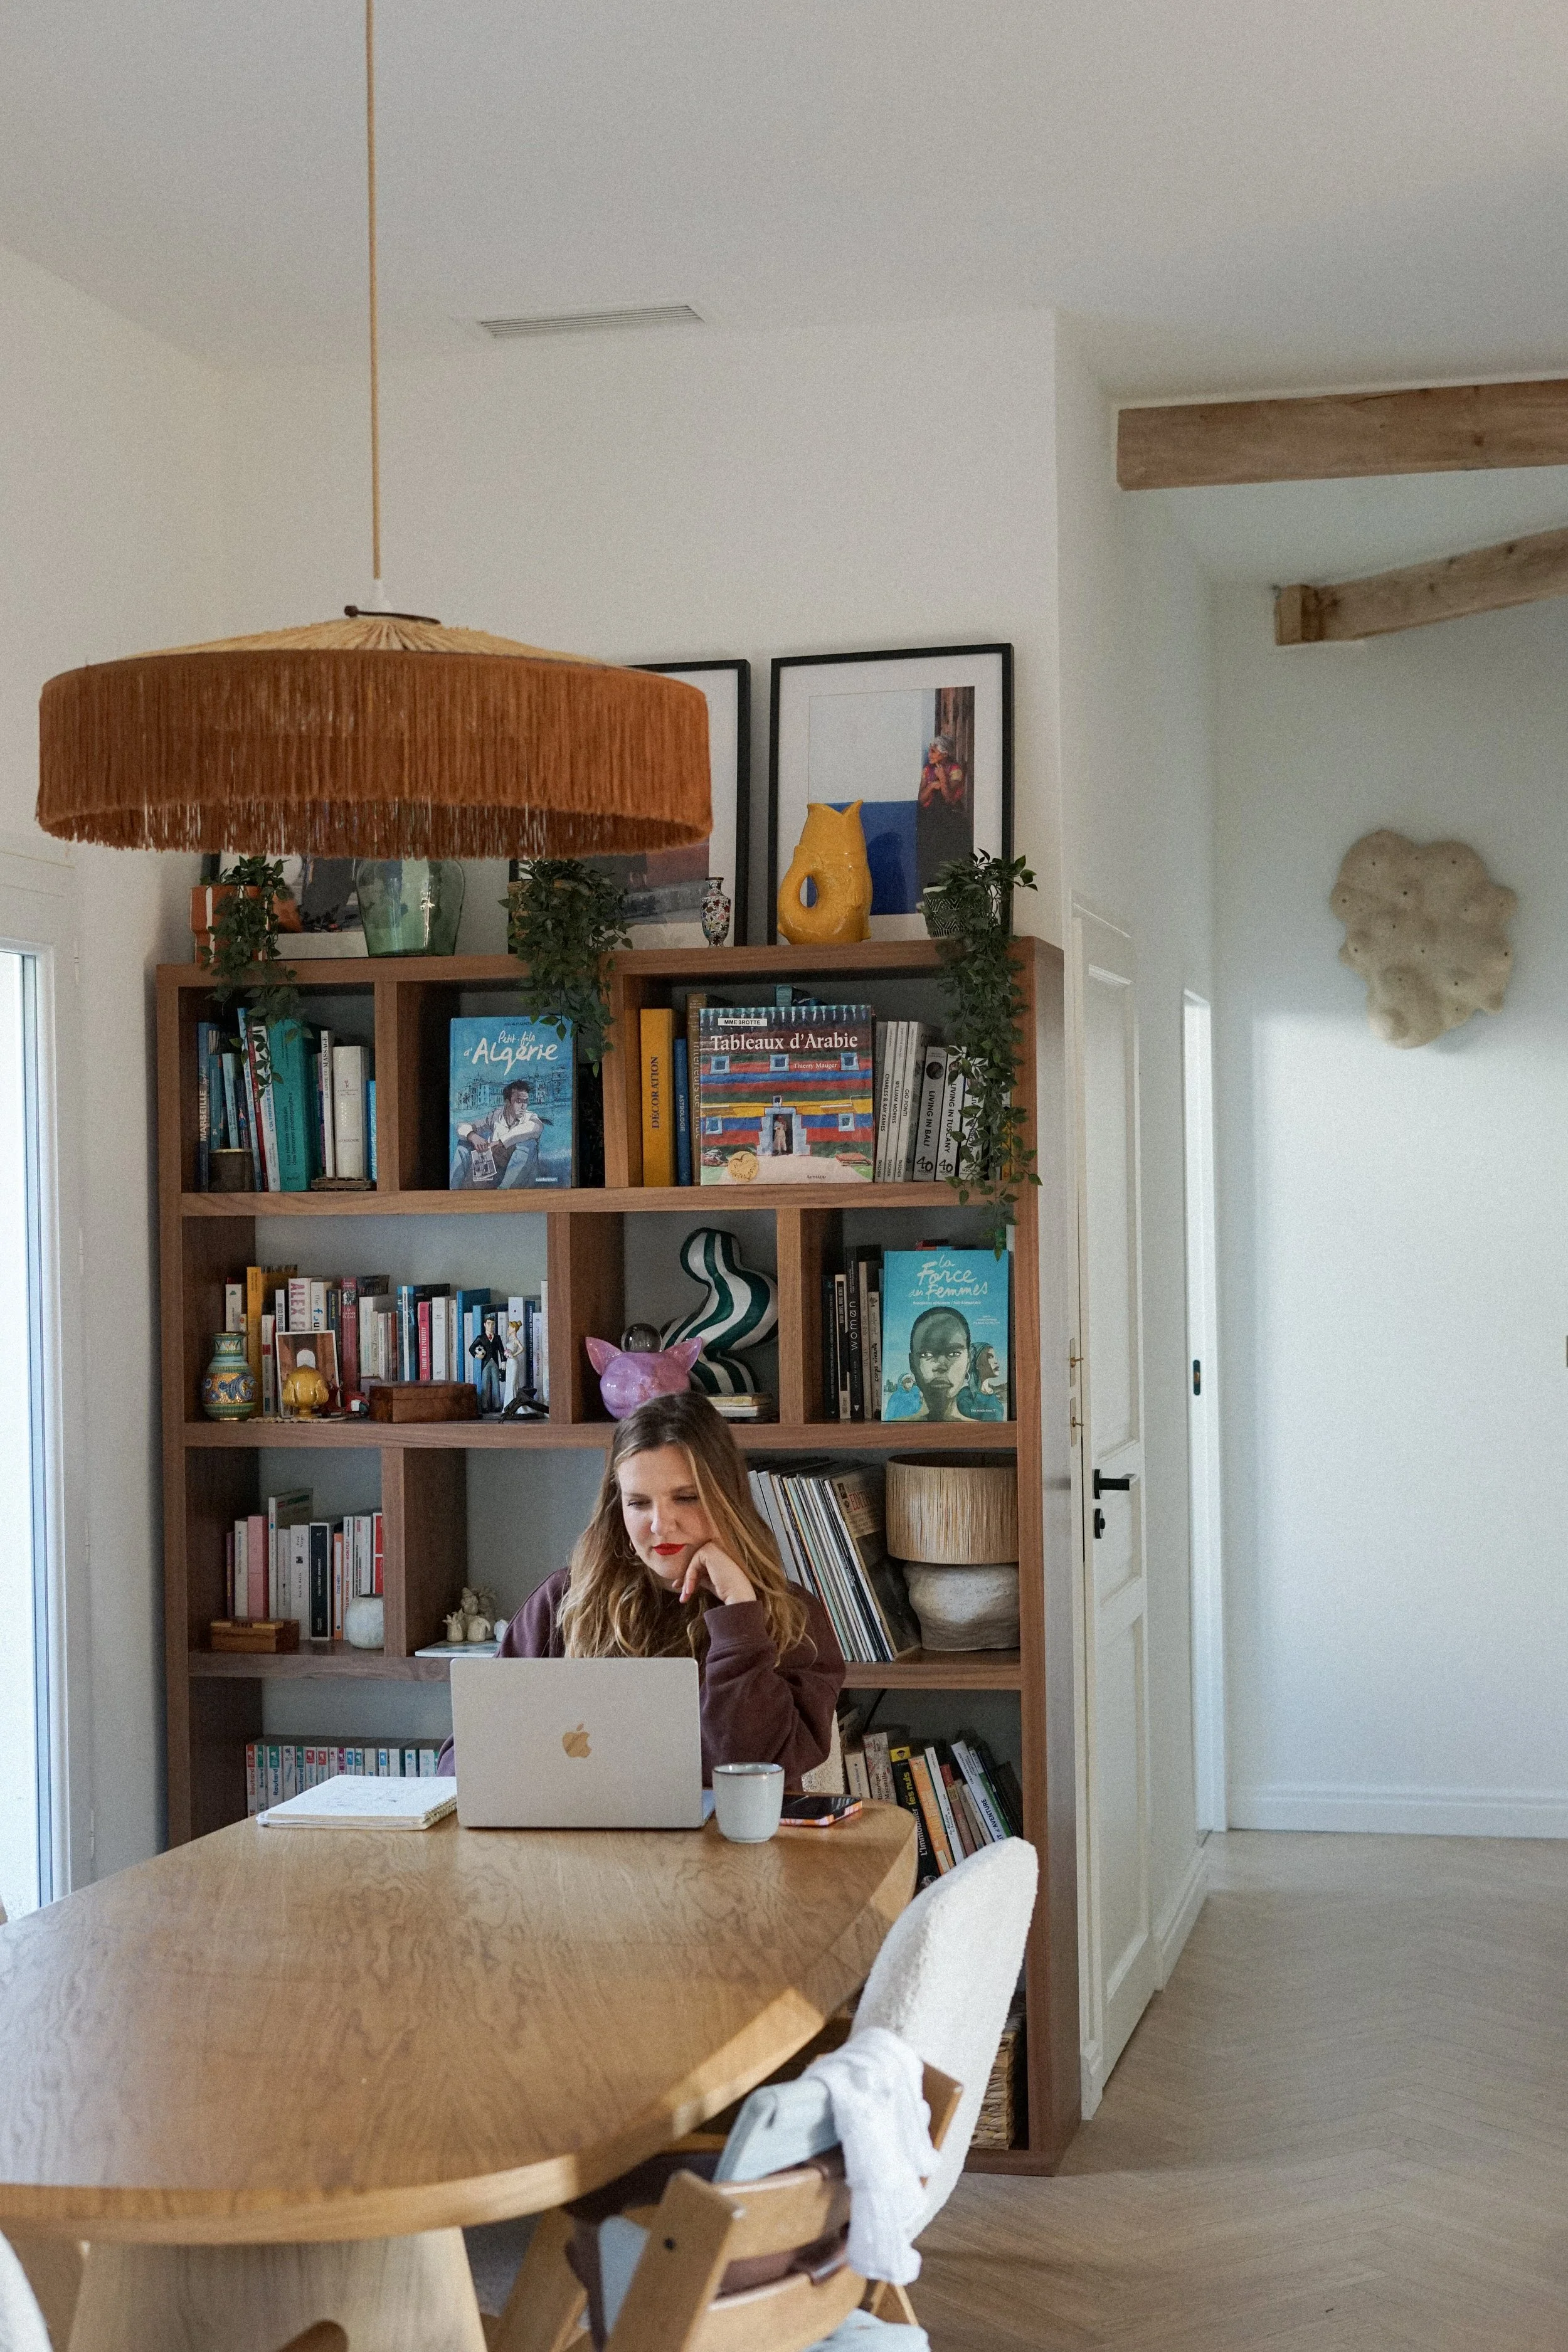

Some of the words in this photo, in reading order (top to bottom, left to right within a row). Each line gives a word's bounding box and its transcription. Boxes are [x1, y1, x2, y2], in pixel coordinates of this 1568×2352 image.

[709, 1034, 784, 1051] Tableaux
[790, 1032, 858, 1049] d'Arabie
[649, 1056, 660, 1129] DÉCORATION
[926, 1091, 936, 1117] LIVING
[948, 1083, 956, 1108] LIVING
[199, 1089, 208, 1142] MARSEILLE
[266, 1097, 274, 1132] L'OLYMPIQUE
[288, 1092, 296, 1131] photographes
[925, 1119, 932, 1128] IN
[948, 1109, 954, 1117] IN
[944, 1119, 953, 1153] TUSCANY
[916, 1156, 933, 1172] 40
[938, 1159, 953, 1172] 40
[916, 1261, 977, 1286] Force
[939, 1254, 956, 1268] la
[290, 1283, 305, 1316] ALEX
[908, 1289, 923, 1298] des
[925, 1281, 988, 1301] Femmes
[881, 1772, 891, 1803] Marseille
[903, 1771, 913, 1791] nuls
[908, 1791, 916, 1806] les
[980, 1798, 1000, 1832] d'AVENTURE
